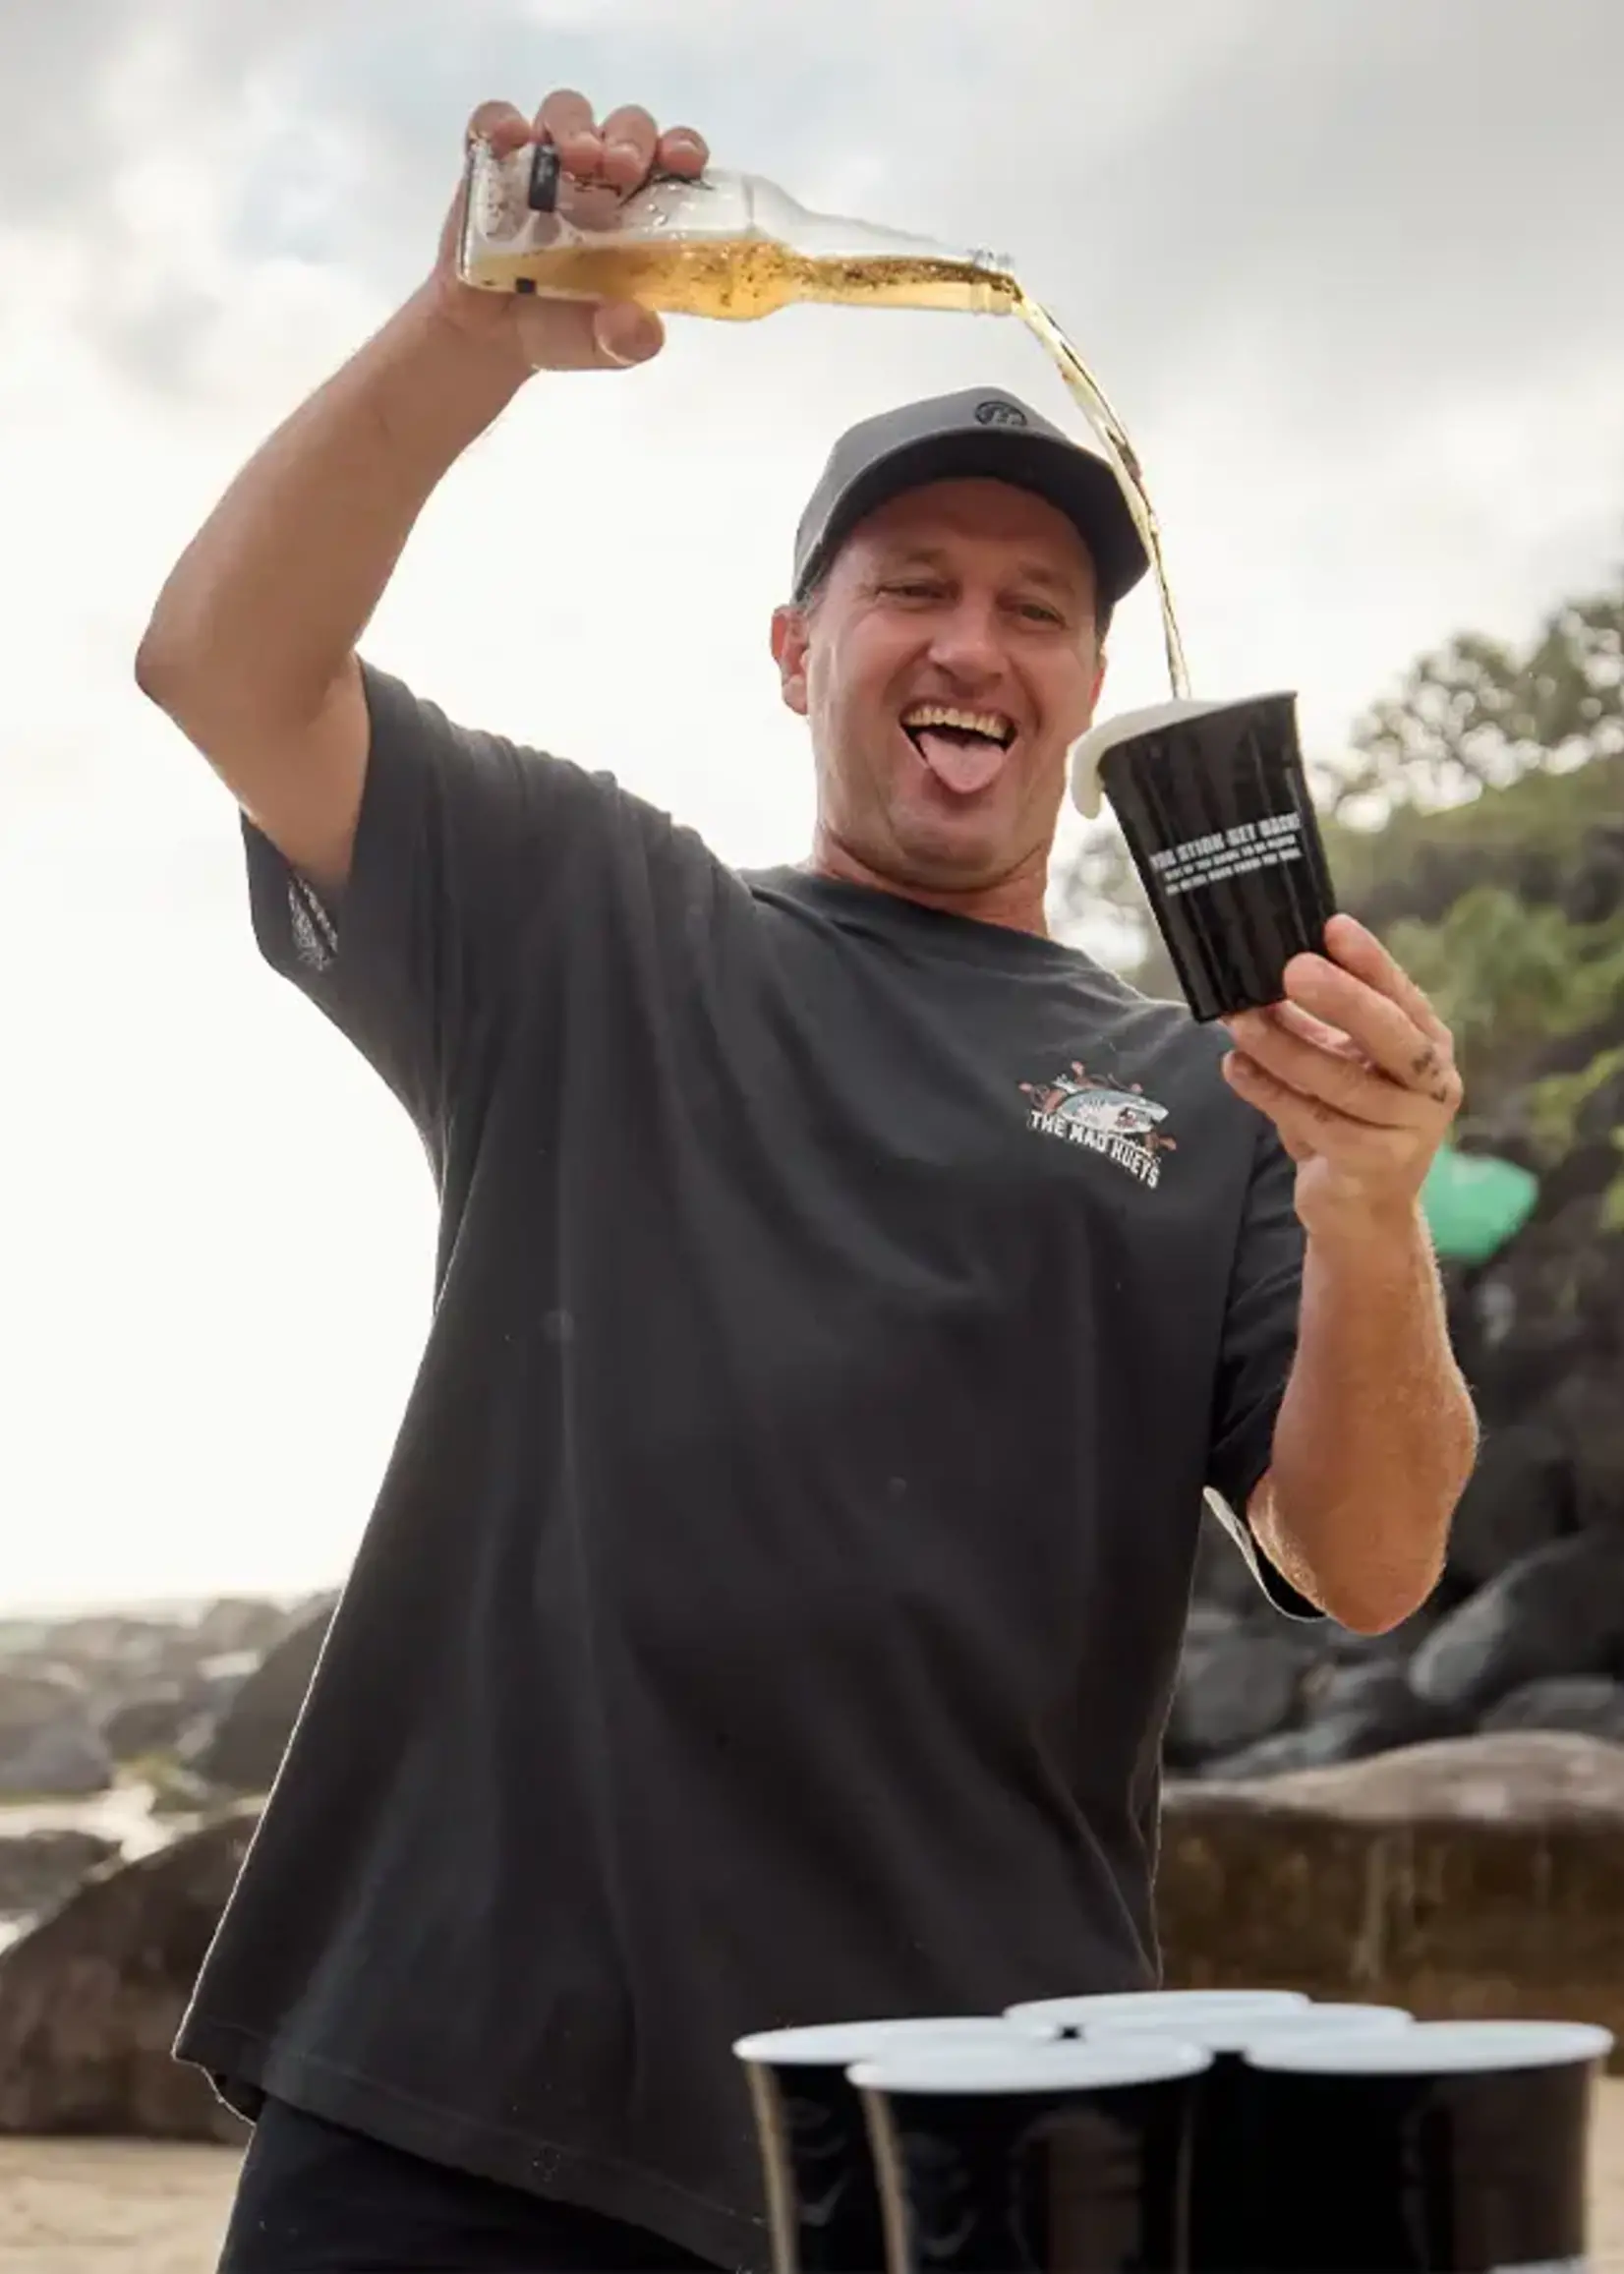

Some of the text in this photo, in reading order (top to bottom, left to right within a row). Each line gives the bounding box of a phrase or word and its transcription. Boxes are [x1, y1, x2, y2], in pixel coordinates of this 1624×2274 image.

[1030, 1110, 1161, 1190] THE MAD HUEYS
